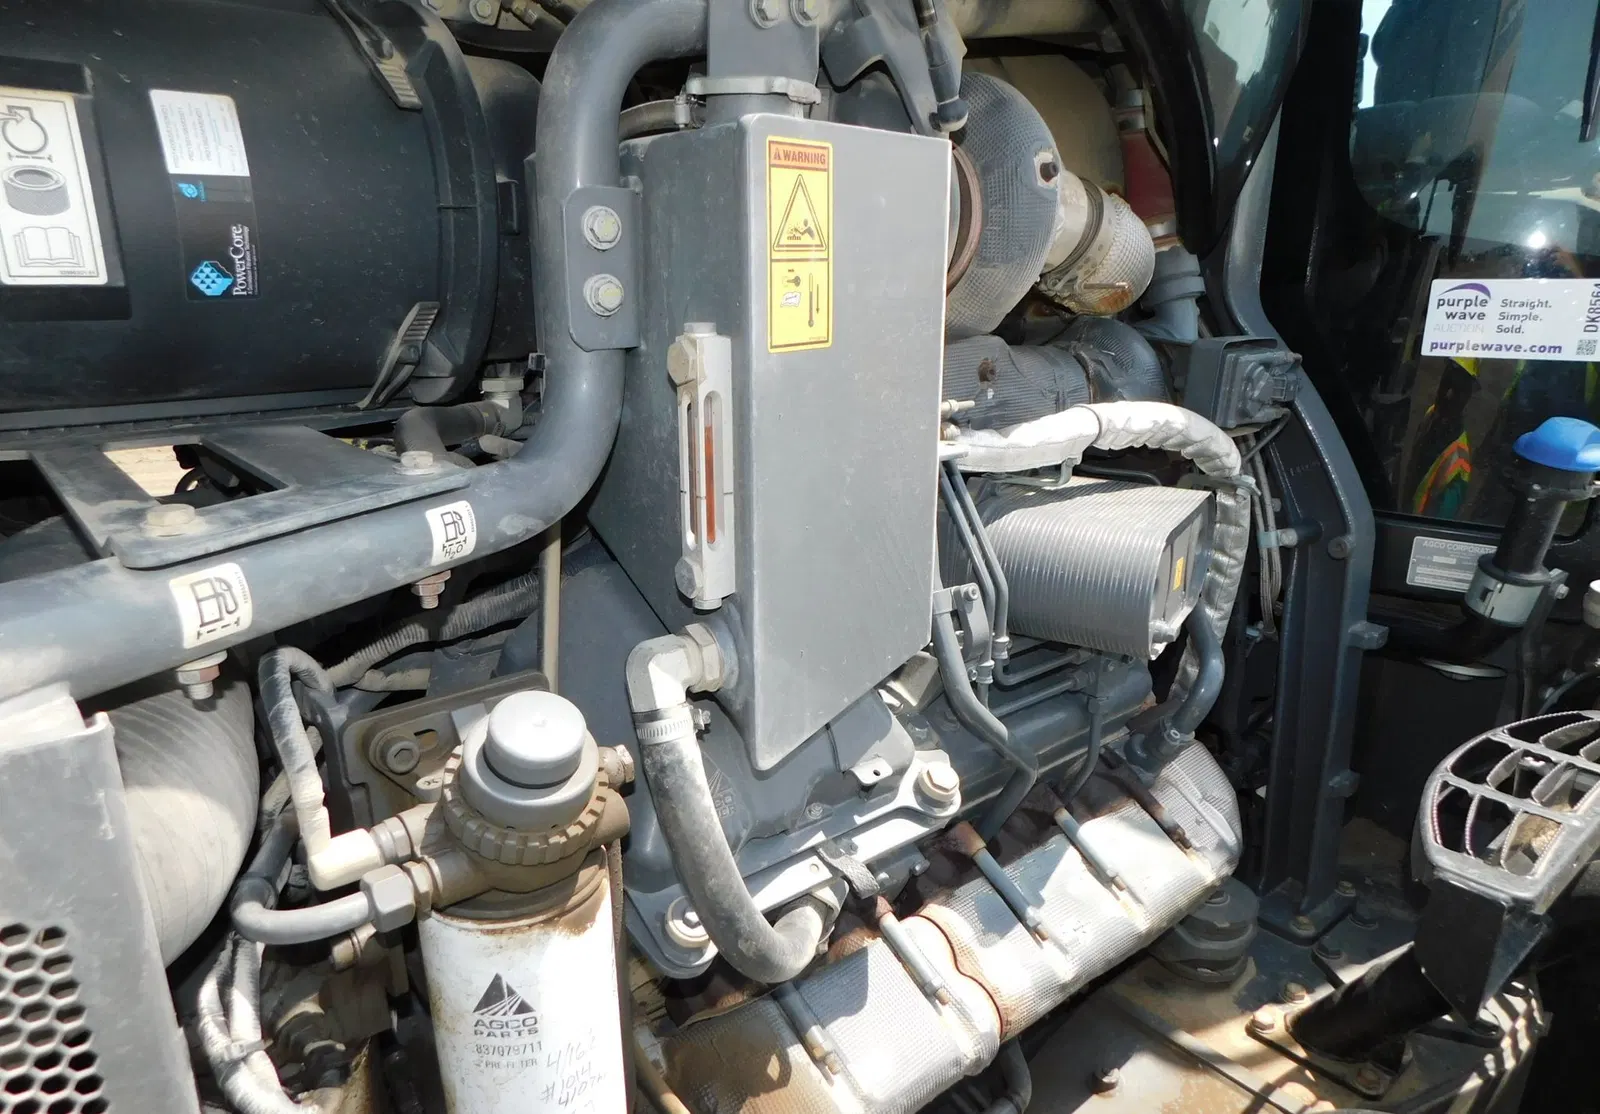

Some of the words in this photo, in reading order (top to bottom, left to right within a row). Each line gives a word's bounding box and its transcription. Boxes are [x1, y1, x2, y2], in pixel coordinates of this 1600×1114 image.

[783, 150, 826, 164] WARNING
[230, 224, 247, 296] PowerCore
[1436, 294, 1489, 310] purple
[1500, 298, 1552, 311] Straight.
[1445, 311, 1486, 321] wave
[1498, 311, 1543, 323] Simple.
[1496, 324, 1525, 334] Sold.
[1429, 340, 1563, 354] purplewave.com
[1422, 540, 1446, 549] AGCO
[474, 1016, 538, 1030] AGCO
[474, 1027, 539, 1038] PARTS
